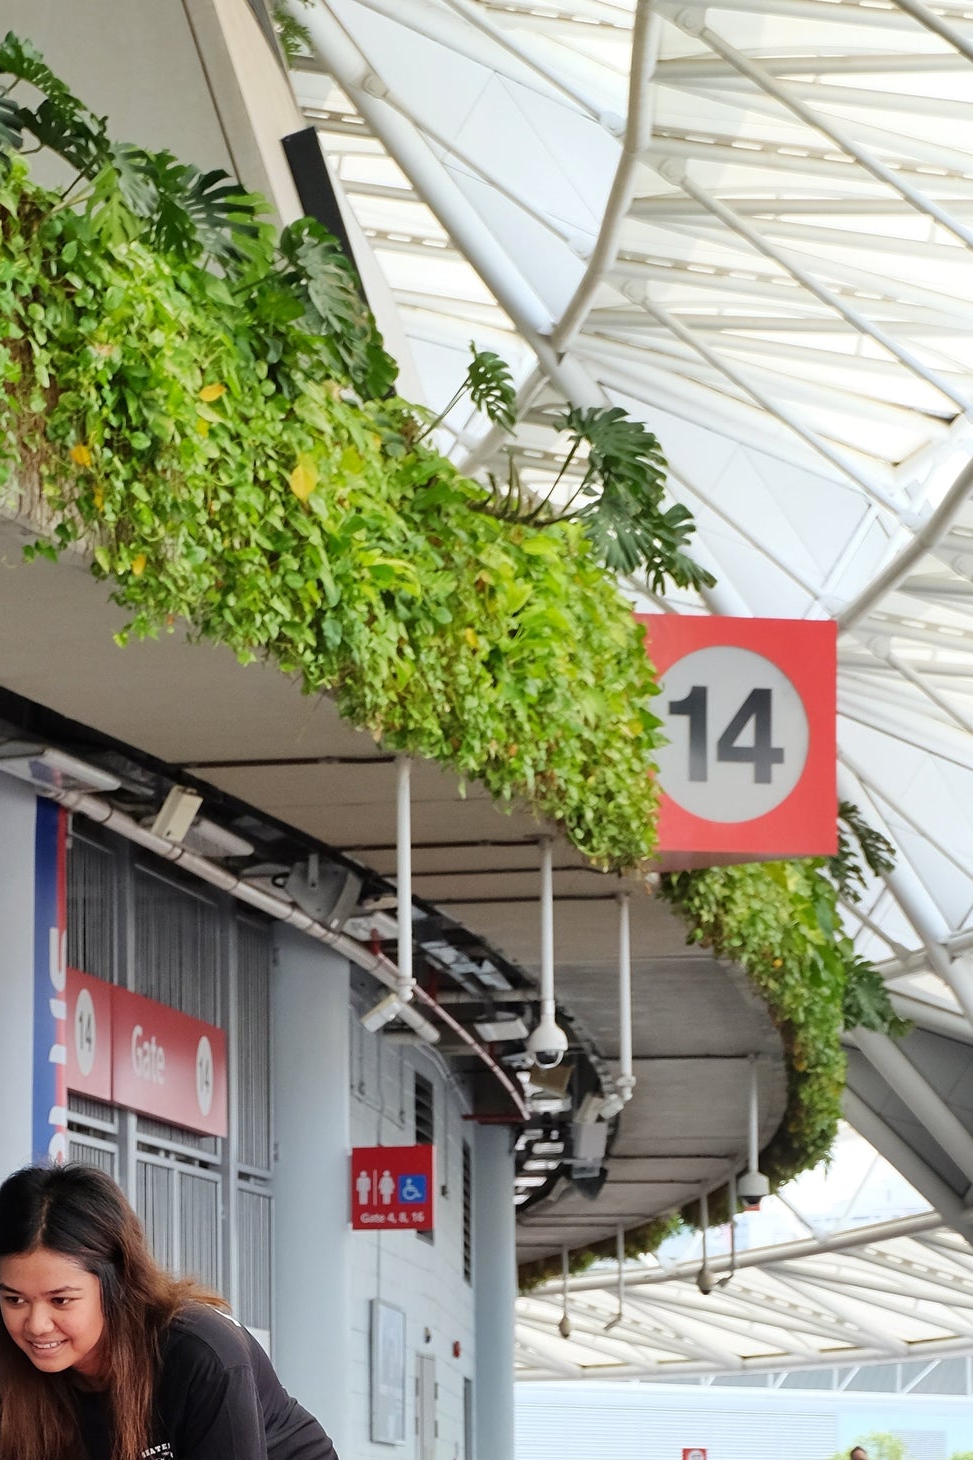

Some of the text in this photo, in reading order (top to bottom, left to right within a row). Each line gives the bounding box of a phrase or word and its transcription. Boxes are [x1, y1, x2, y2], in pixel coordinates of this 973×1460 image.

[668, 685, 784, 784] 14
[79, 1010, 92, 1052] 14
[131, 1024, 210, 1094] Gate 14
[360, 1212, 385, 1223] Gate
[411, 1211, 425, 1222] 16
